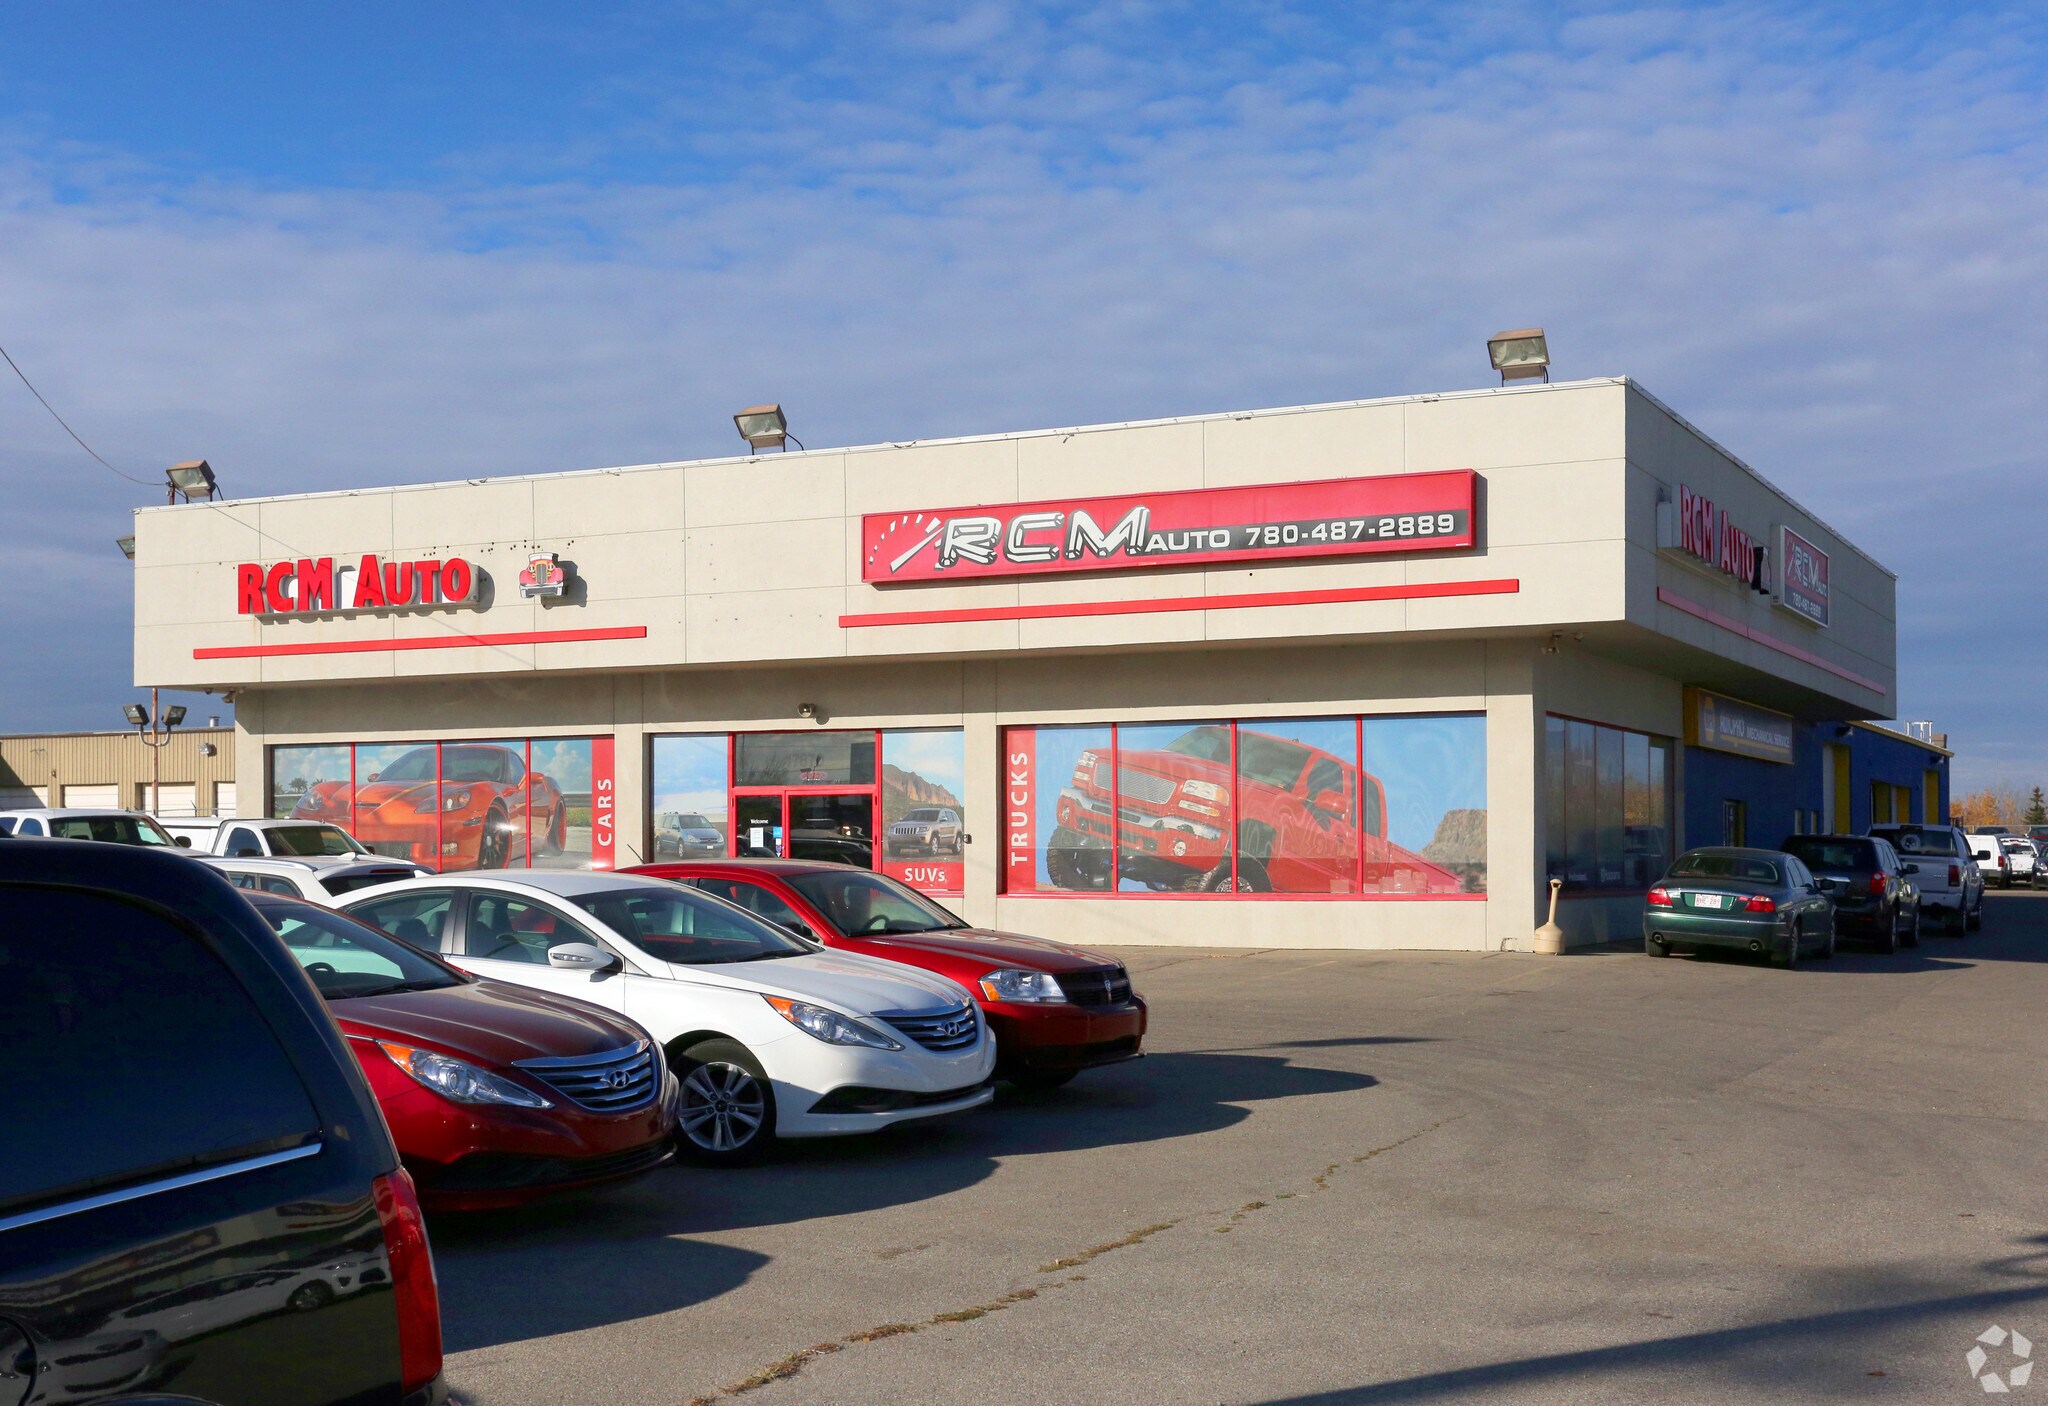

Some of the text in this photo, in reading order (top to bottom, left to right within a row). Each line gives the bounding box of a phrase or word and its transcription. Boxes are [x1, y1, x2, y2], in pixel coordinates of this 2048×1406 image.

[940, 505, 1455, 567] RCM AUTO 780-487-2889
[1680, 484, 1754, 583] RCM AUTO
[237, 554, 472, 614] RCM AUTO
[597, 779, 612, 847] CARS
[1011, 752, 1028, 866] TRUCKS
[904, 867, 946, 882] SUVs
